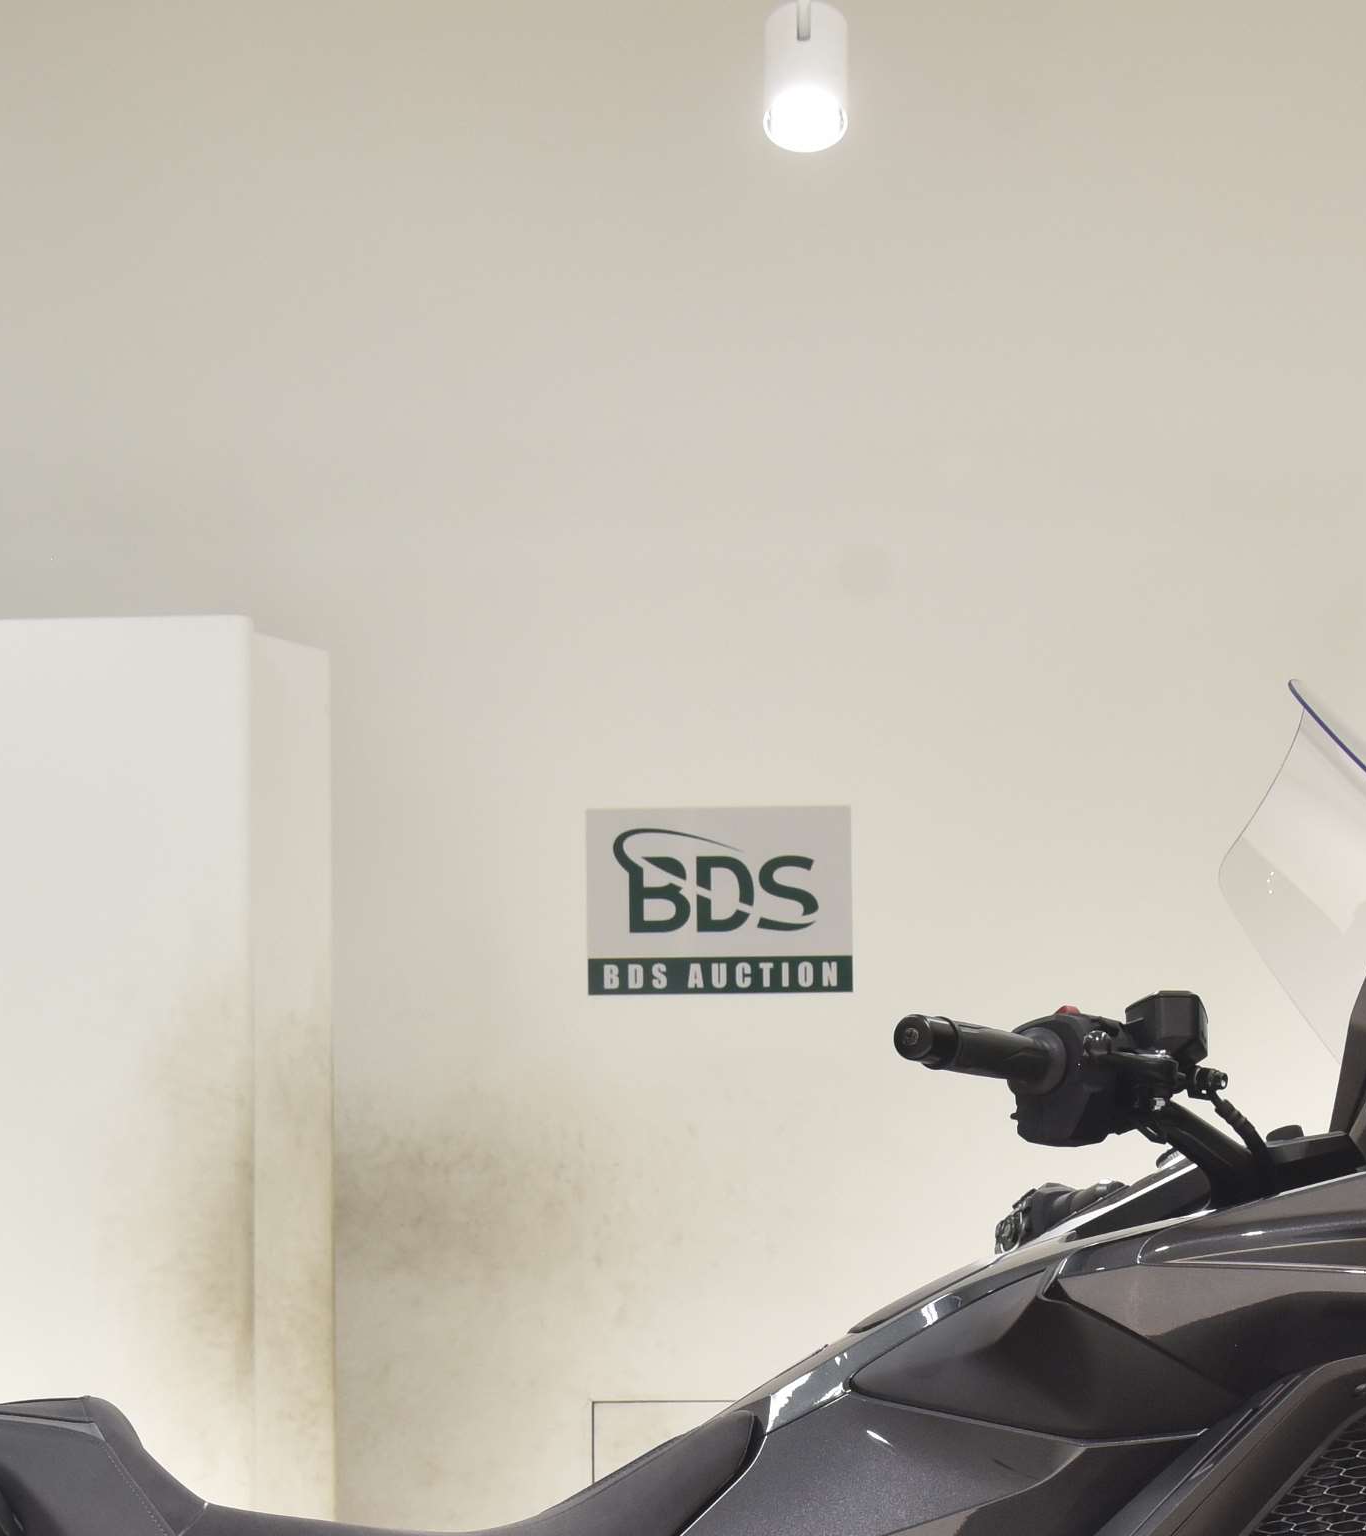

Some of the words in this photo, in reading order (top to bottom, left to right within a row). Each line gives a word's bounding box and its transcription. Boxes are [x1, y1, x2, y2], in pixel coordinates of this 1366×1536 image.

[613, 828, 820, 932] BDS
[602, 962, 669, 990] BDS
[687, 960, 839, 989] AUCTION
